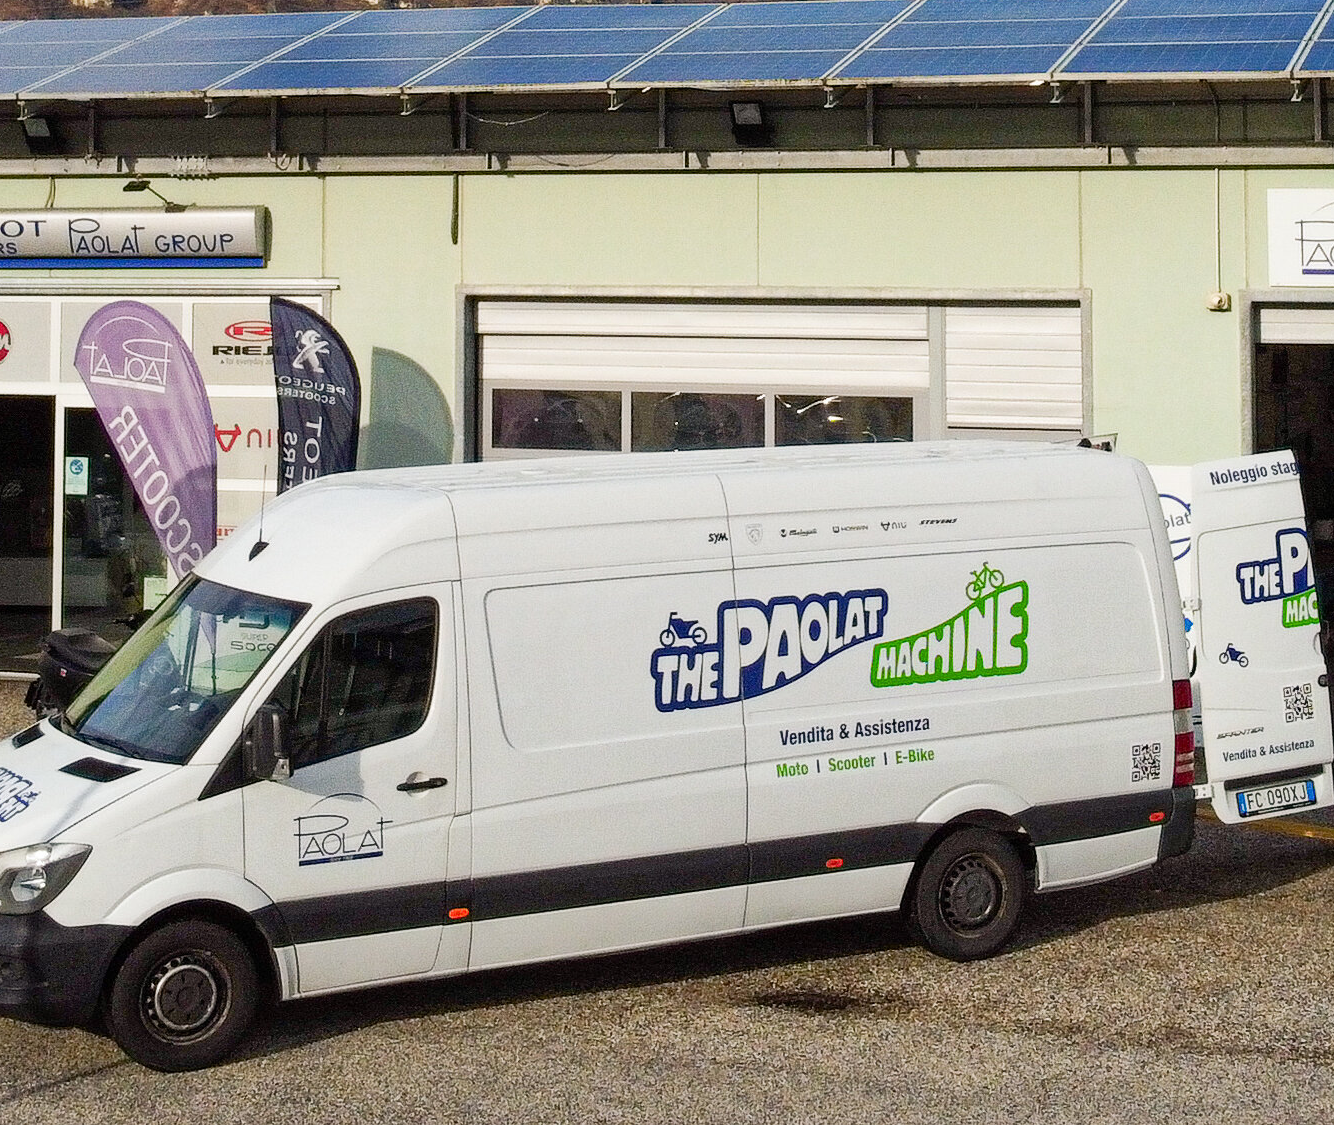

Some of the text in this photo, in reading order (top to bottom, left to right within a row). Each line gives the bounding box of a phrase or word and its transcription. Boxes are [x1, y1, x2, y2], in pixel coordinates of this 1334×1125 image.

[154, 234, 235, 254] GROUP
[1209, 464, 1268, 486] Noleggio
[708, 532, 729, 543] SYM
[1240, 562, 1281, 600] THE
[657, 585, 1024, 705] THE PAOLAT MACHINE
[779, 717, 931, 746] Vendita & Assistenza
[776, 761, 809, 778] Moto
[828, 755, 876, 772] Scooter
[895, 748, 935, 765] E-Bike
[1222, 739, 1315, 762] Vendita & Assistenza
[1246, 784, 1307, 810] FC 090XJ
